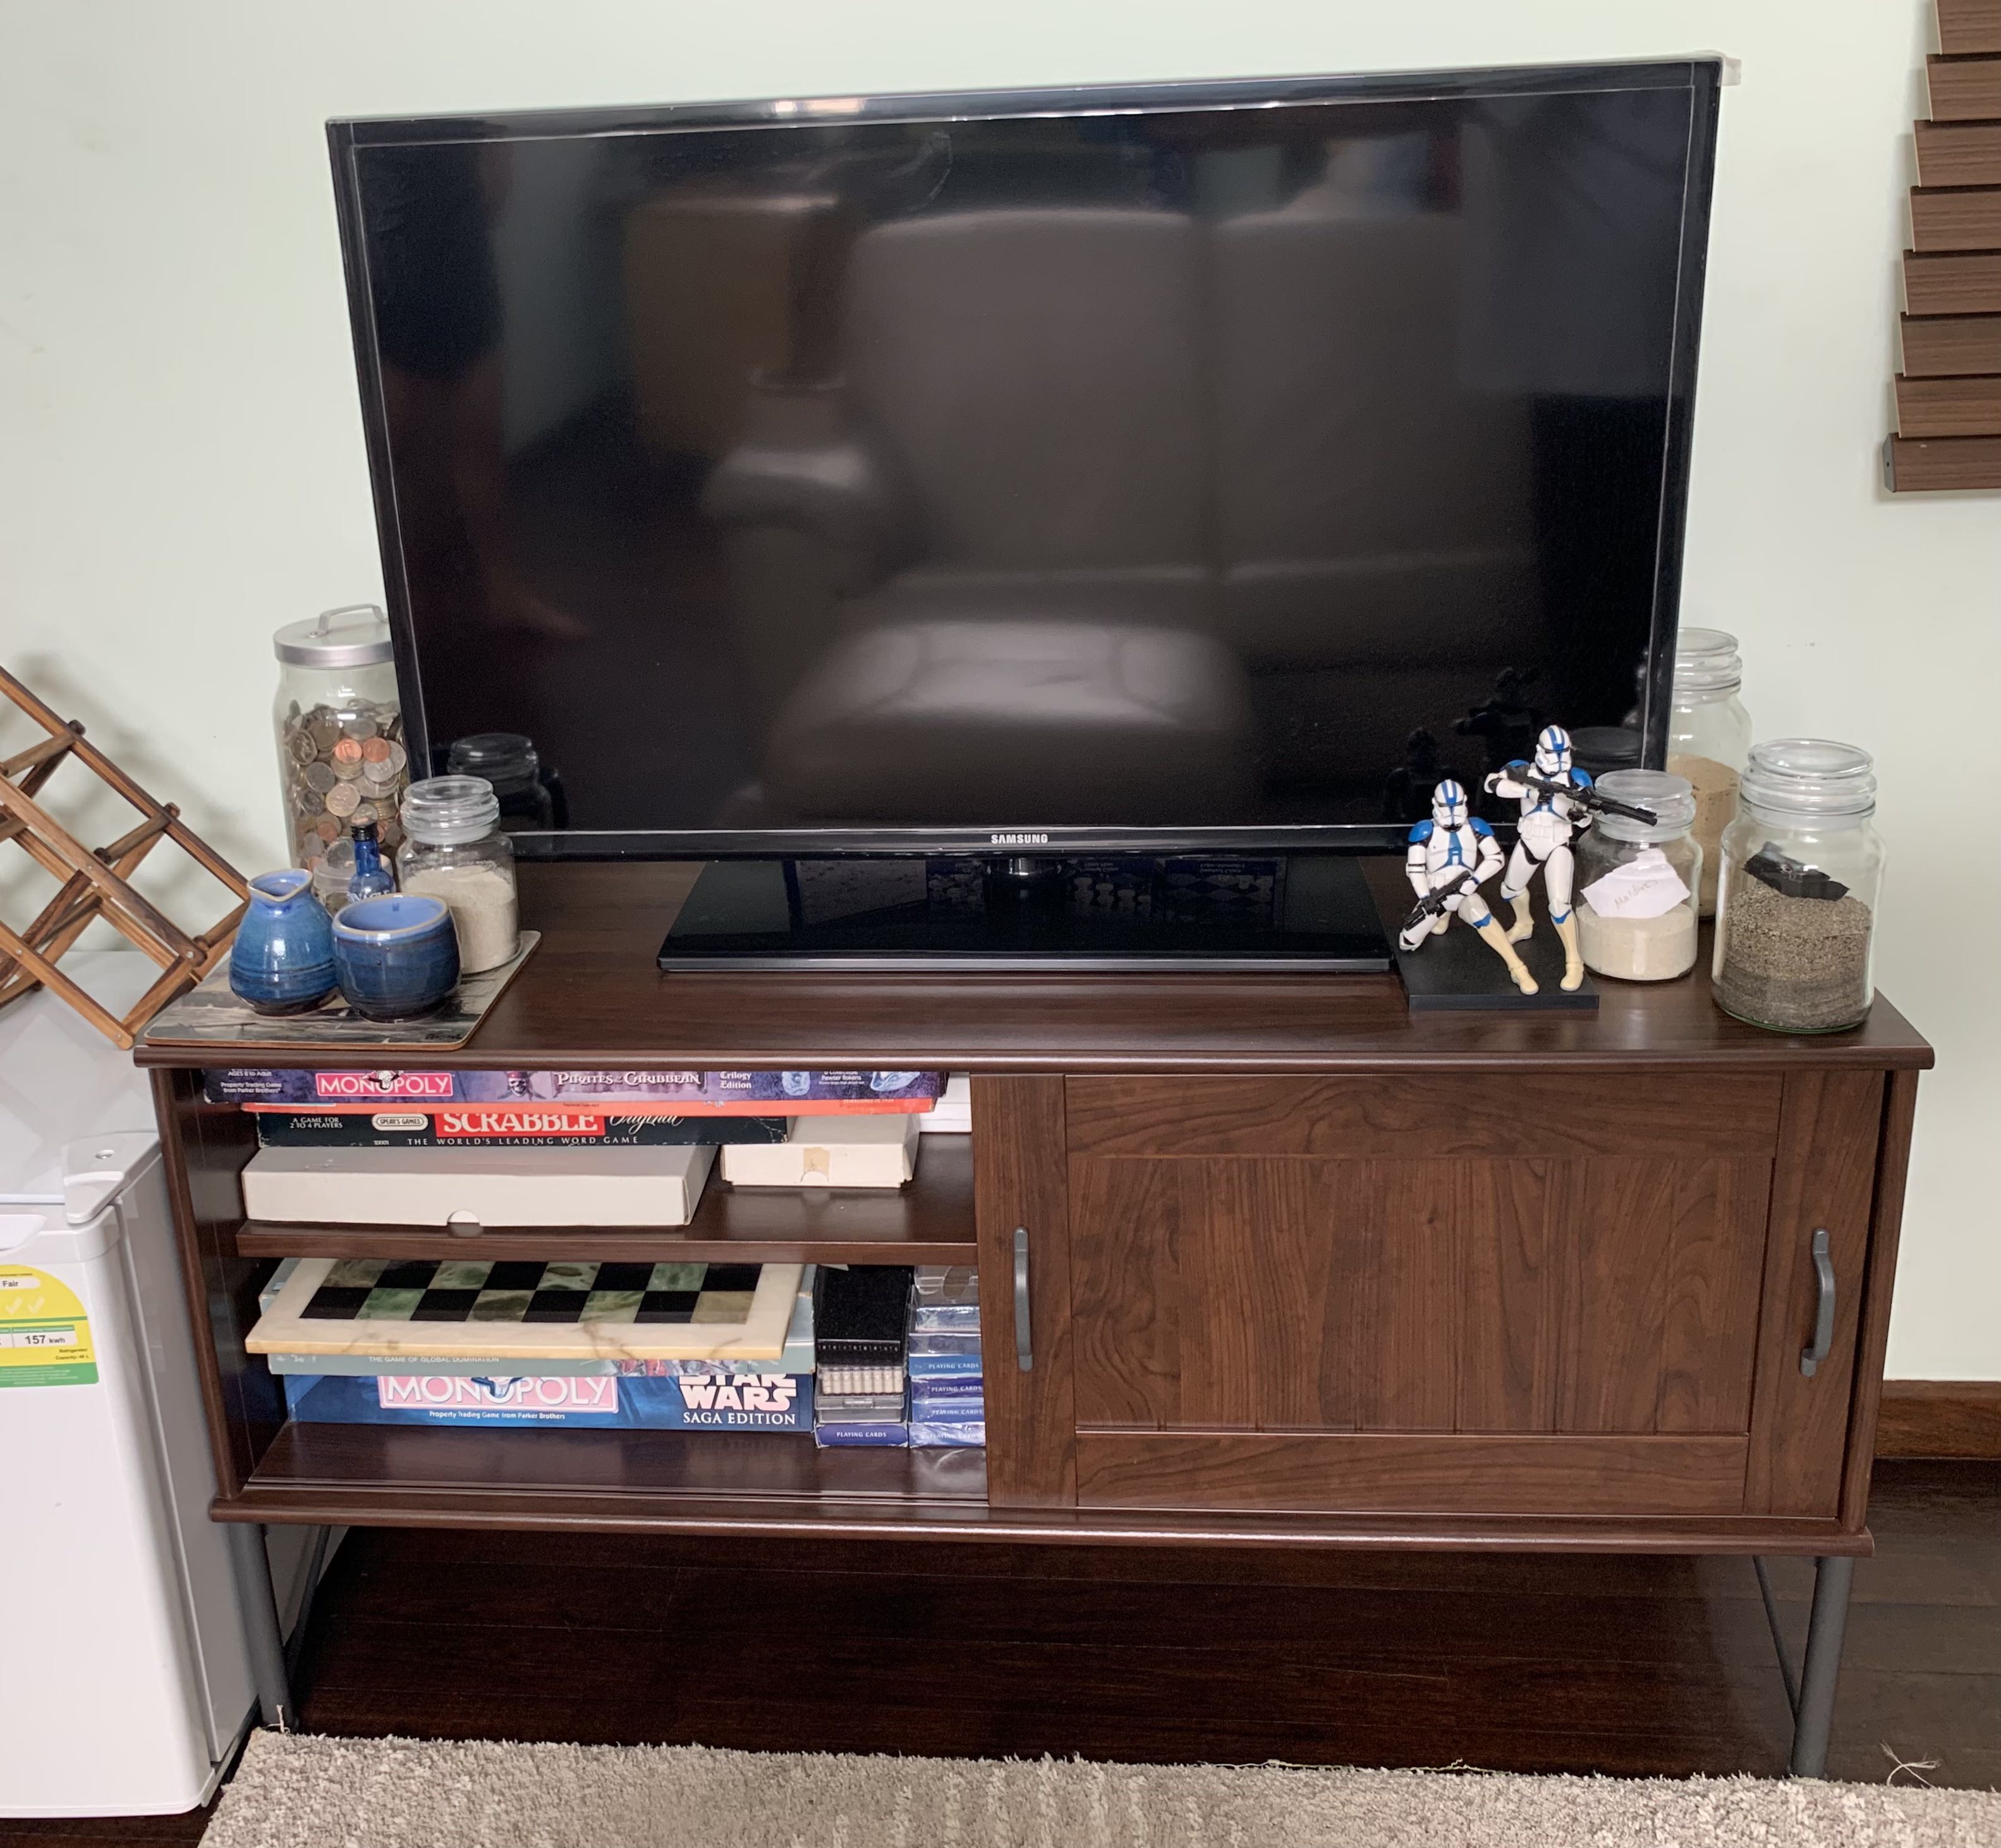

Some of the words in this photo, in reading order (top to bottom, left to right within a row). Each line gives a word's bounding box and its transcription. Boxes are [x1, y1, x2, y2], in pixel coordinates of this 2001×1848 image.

[991, 834, 1048, 844] SAMSUNG
[720, 1071, 751, 1081] Trilogy
[320, 1076, 449, 1093] MONOPOLY
[720, 1080, 751, 1089] Edition
[443, 1114, 598, 1132] SCRABBLE
[25, 1335, 46, 1344] 157
[387, 1376, 607, 1404] MONOPOLY
[679, 1385, 797, 1411] WARS
[683, 1411, 723, 1423] SAGA
[727, 1413, 796, 1425] EDITION
